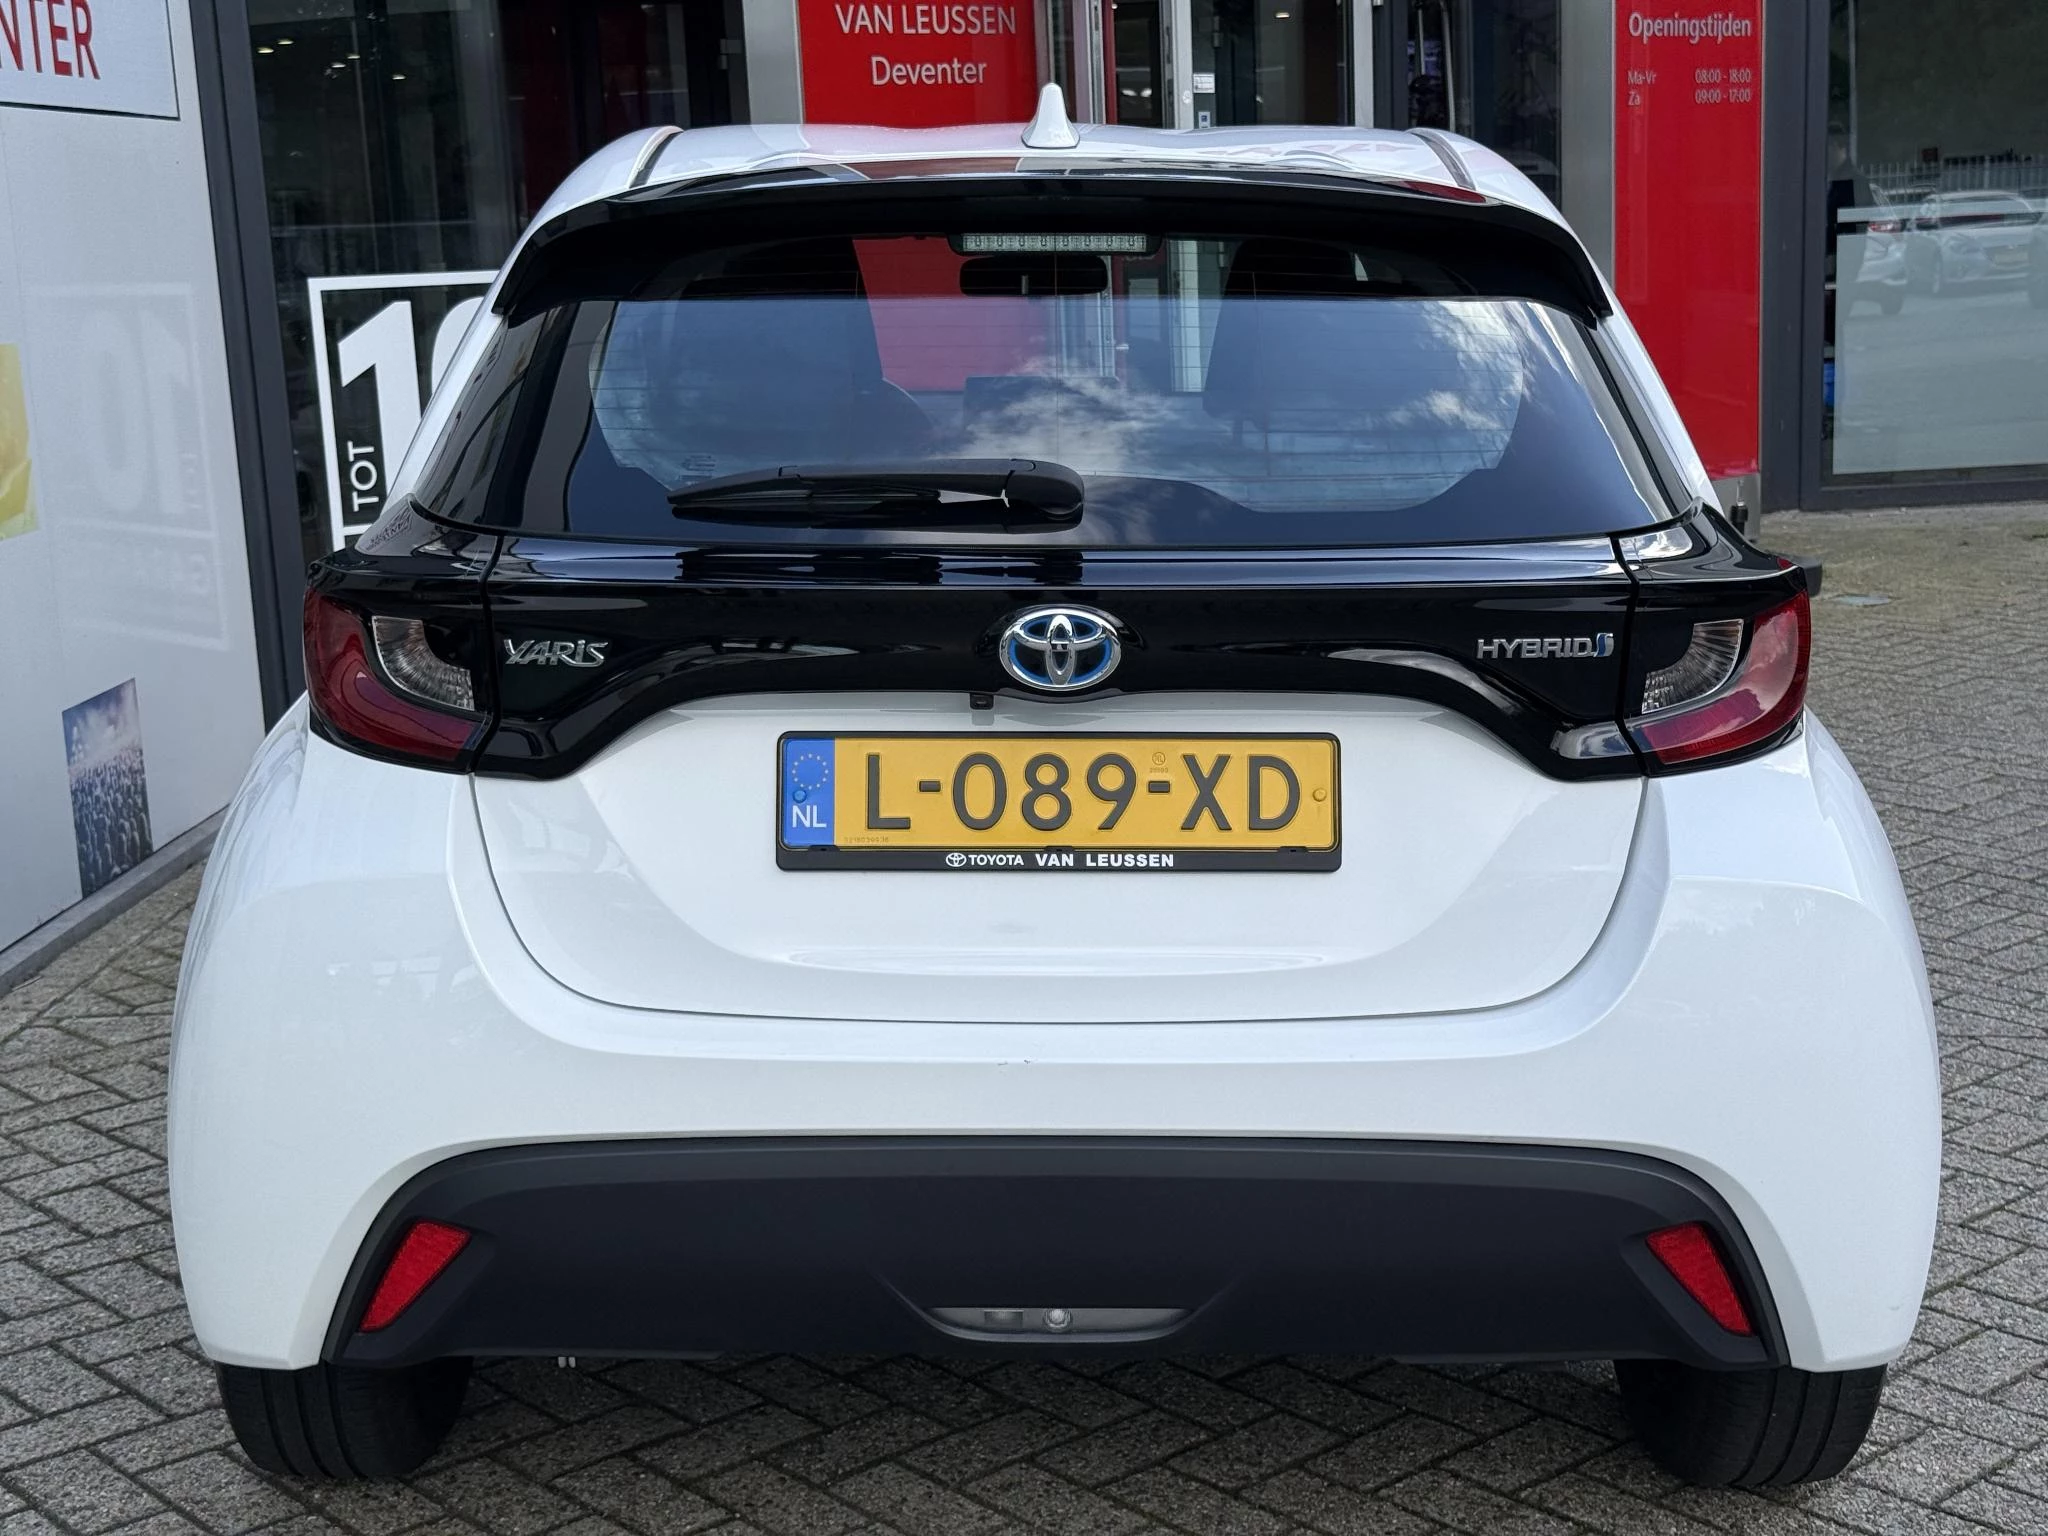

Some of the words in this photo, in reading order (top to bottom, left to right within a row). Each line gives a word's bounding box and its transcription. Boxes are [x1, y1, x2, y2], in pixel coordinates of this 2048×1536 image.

[835, 4, 894, 34] VAN
[902, 5, 1016, 35] LEUSSEN
[1628, 11, 1752, 45] Openingstijden
[871, 56, 988, 86] Deventer
[1628, 90, 1642, 106] Za
[347, 441, 380, 512] TOT
[866, 753, 1301, 832] L-089-XD
[792, 804, 828, 829] NL
[968, 854, 1025, 867] TOYOTA
[1035, 853, 1075, 868] VAN
[1086, 853, 1175, 868] LEUSSEN
